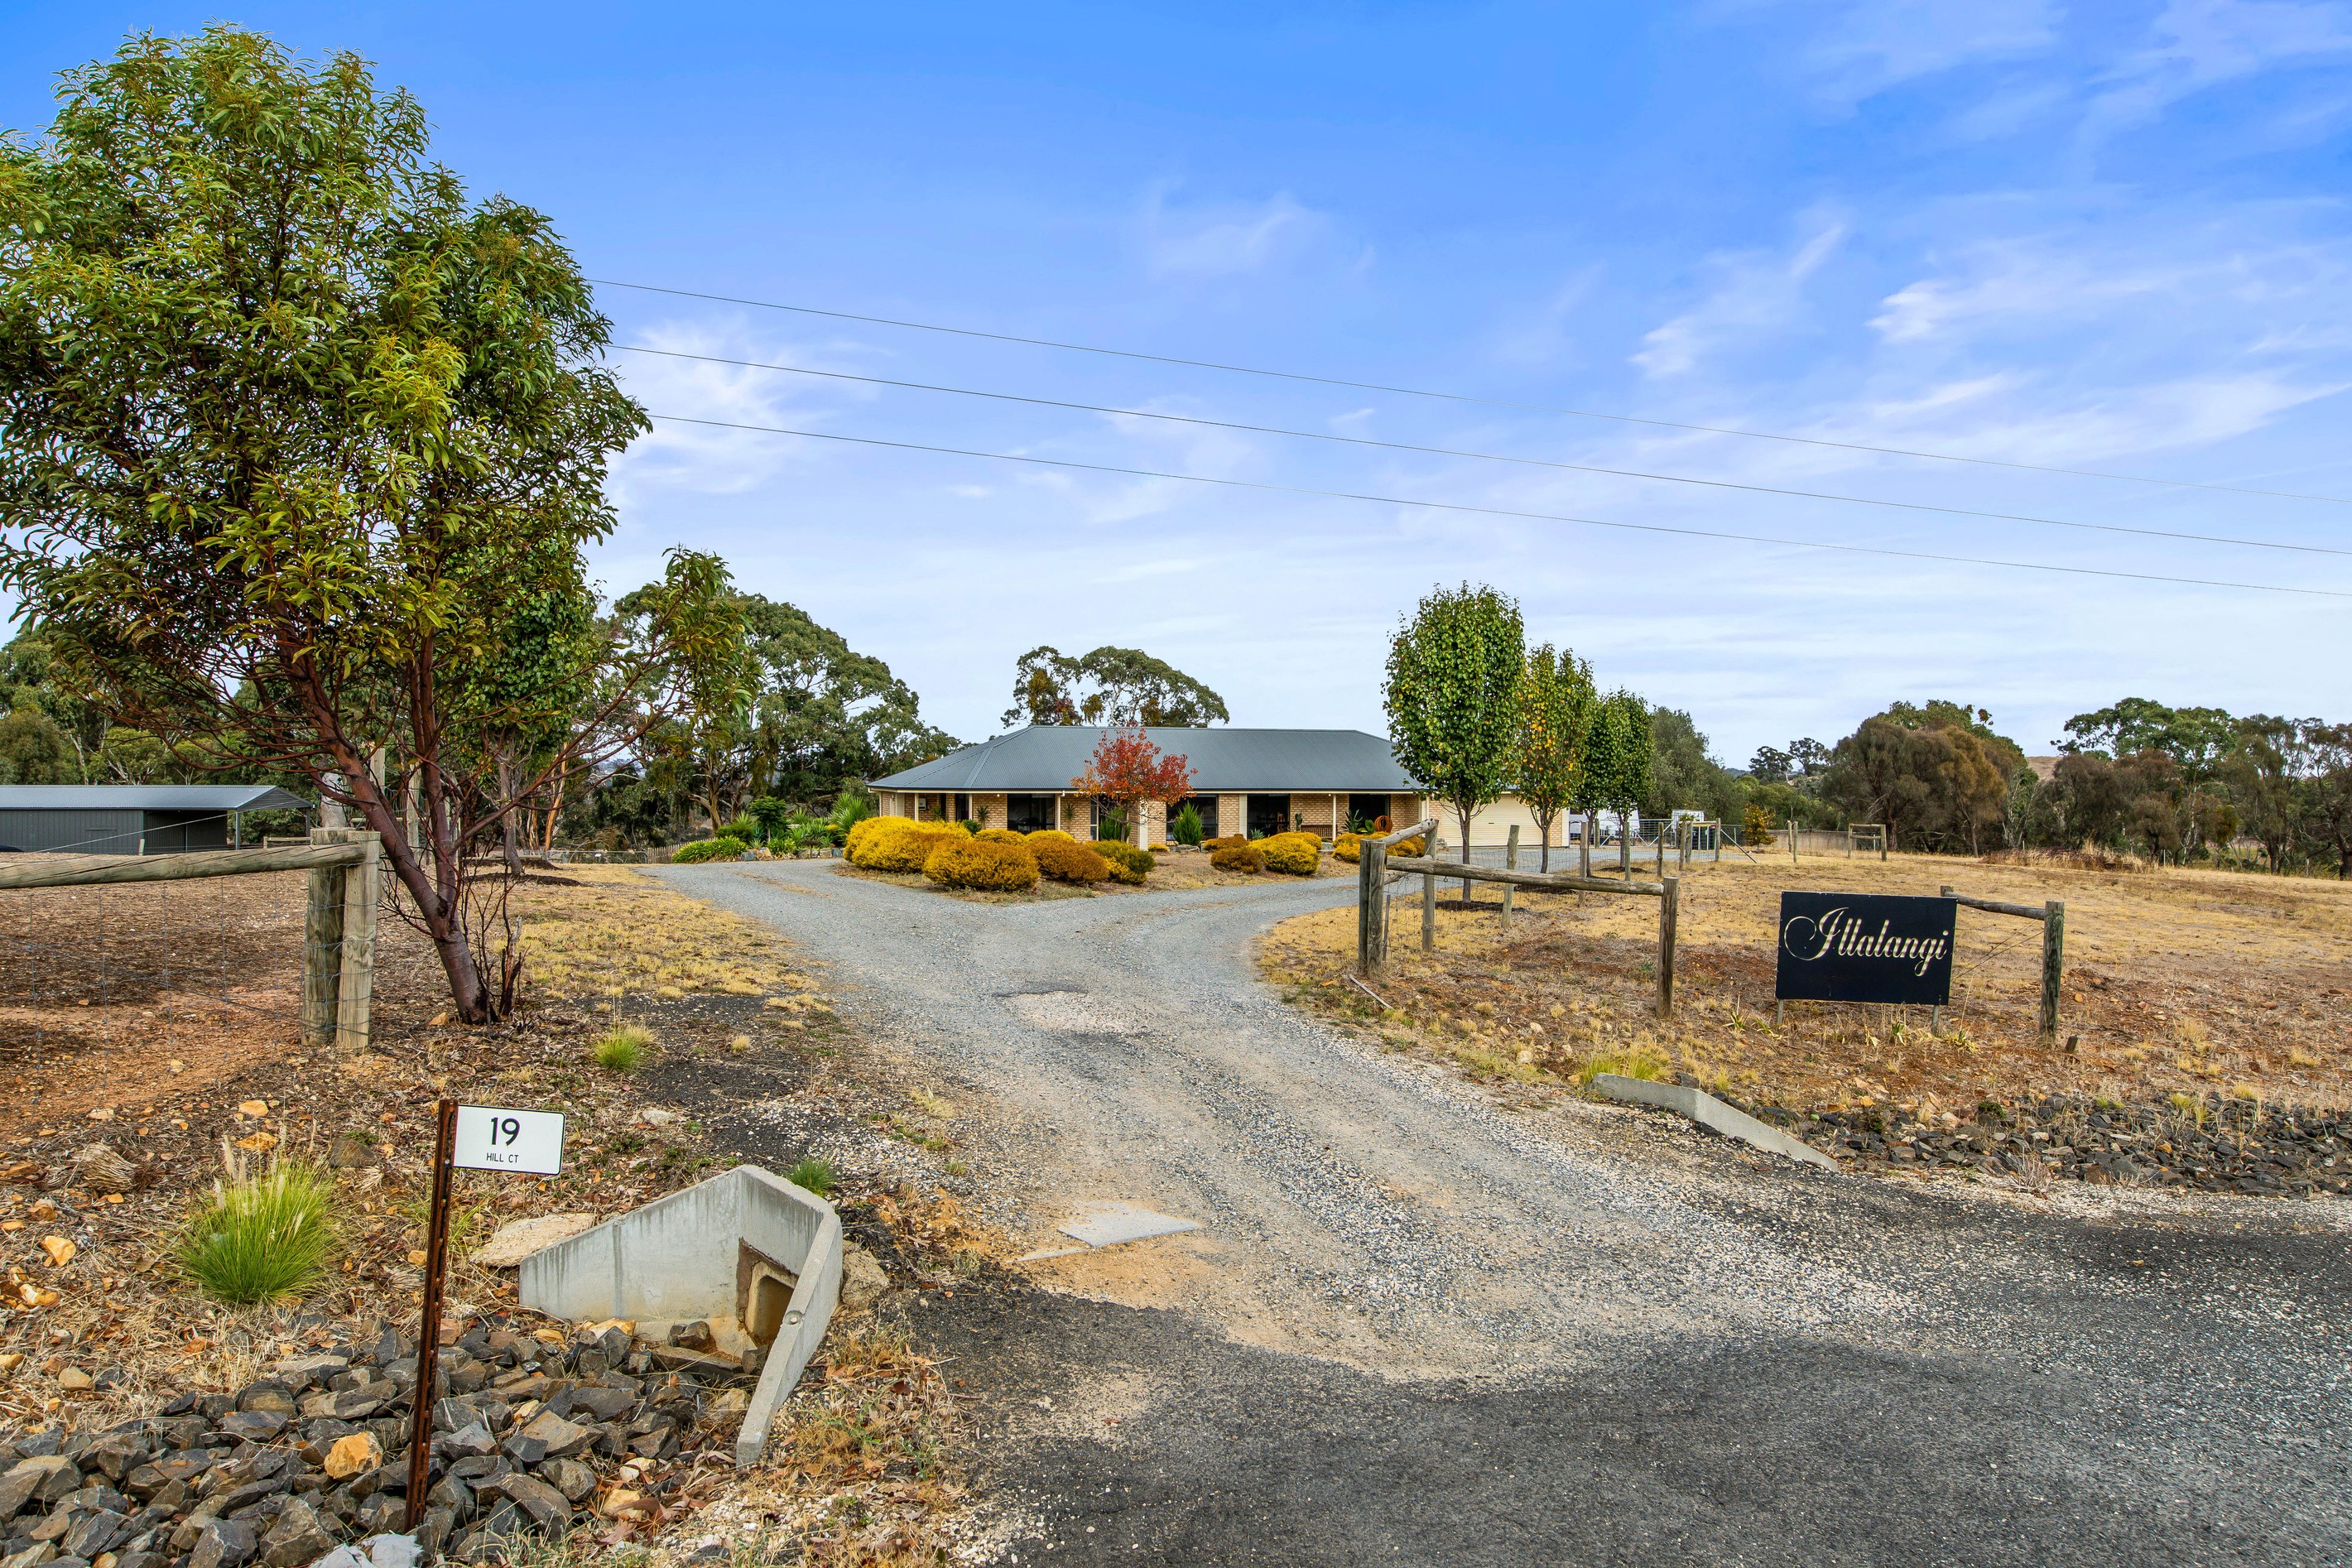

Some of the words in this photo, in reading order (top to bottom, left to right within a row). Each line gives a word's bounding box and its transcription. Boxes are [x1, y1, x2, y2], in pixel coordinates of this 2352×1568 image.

[1784, 907, 1947, 977] Illalangi
[490, 1117, 521, 1147] 19
[486, 1152, 504, 1162] HILL
[508, 1154, 519, 1163] CT
